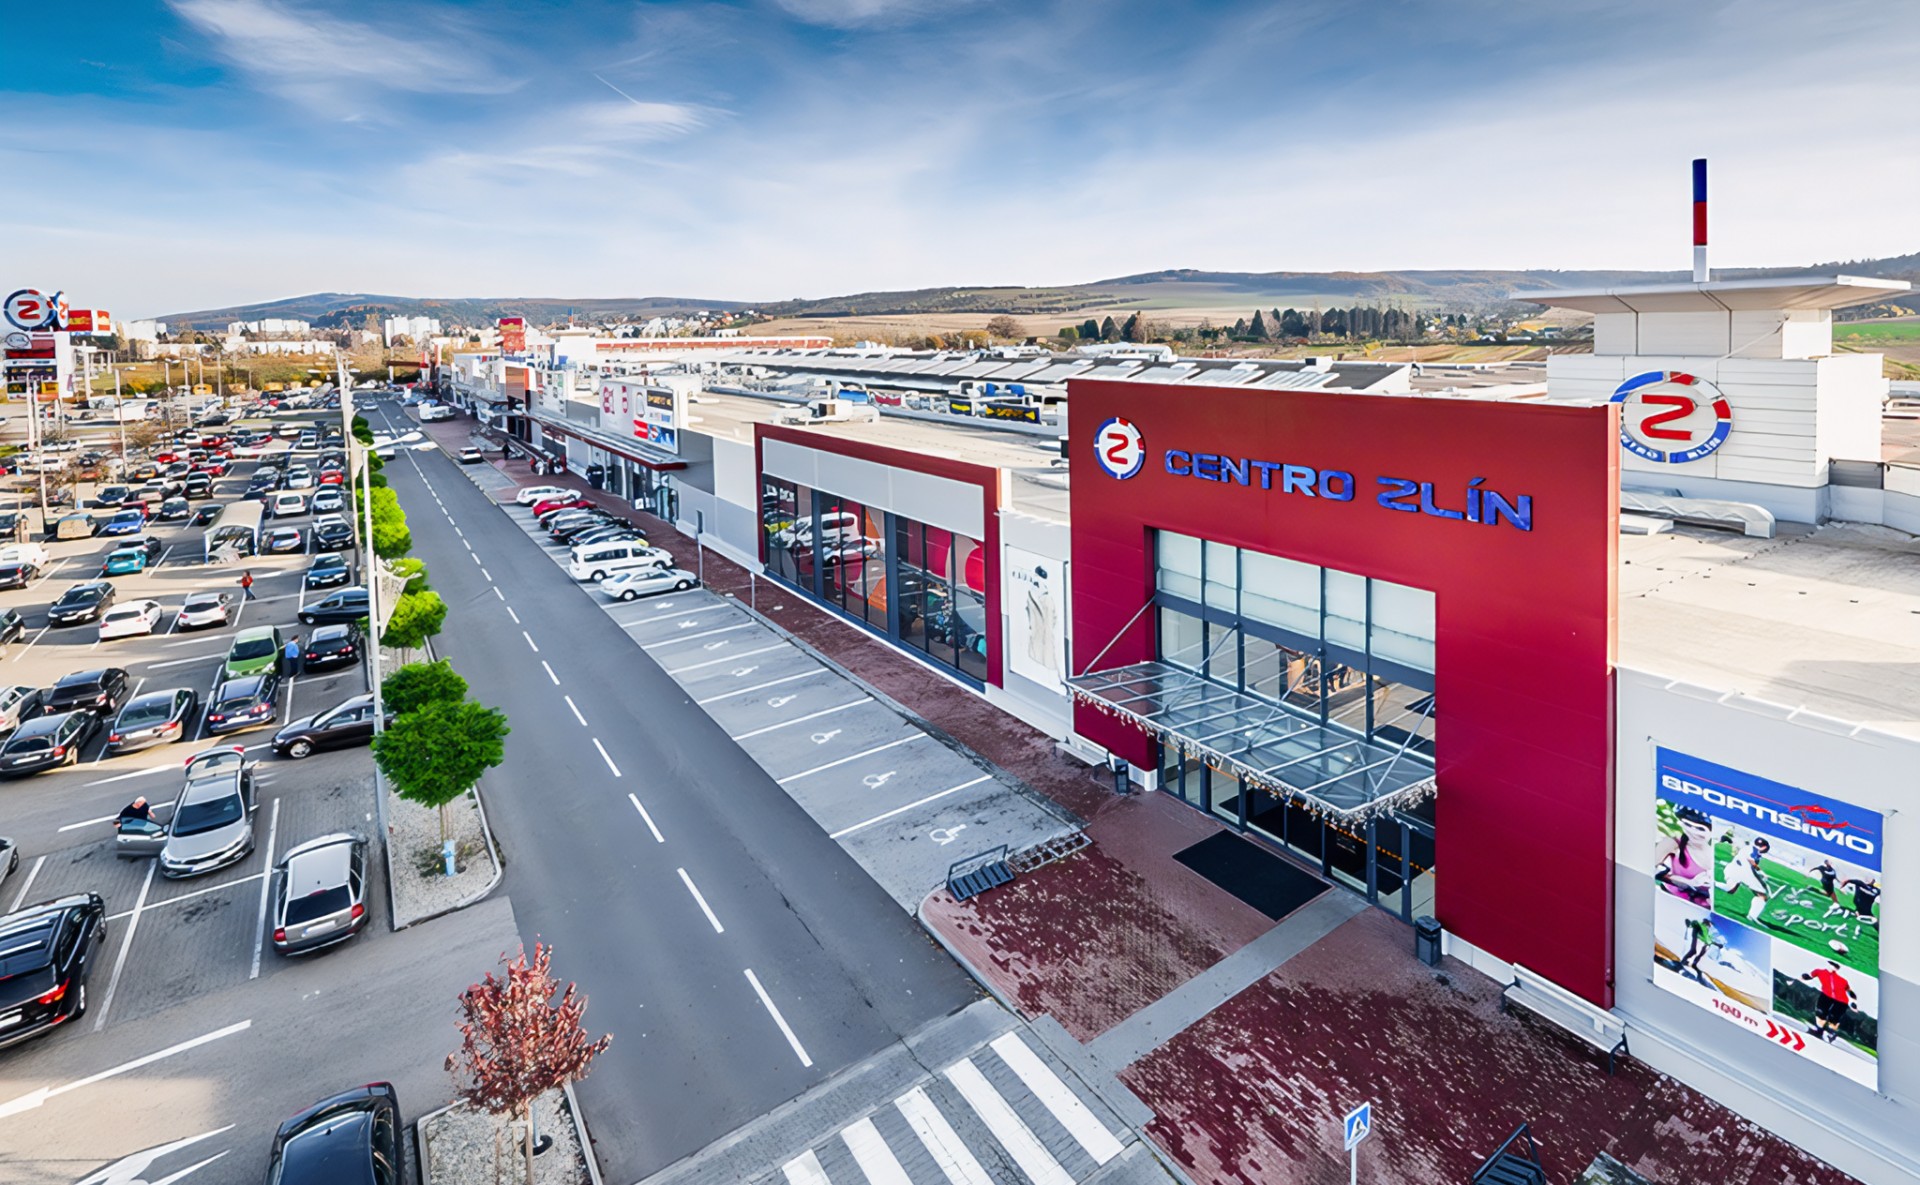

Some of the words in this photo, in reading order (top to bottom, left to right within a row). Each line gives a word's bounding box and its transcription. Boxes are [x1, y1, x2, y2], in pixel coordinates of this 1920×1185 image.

[1164, 449, 1355, 502] CENTRO
[1661, 774, 1874, 856] SPORTISIMO
[1712, 998, 1741, 1019] 100
